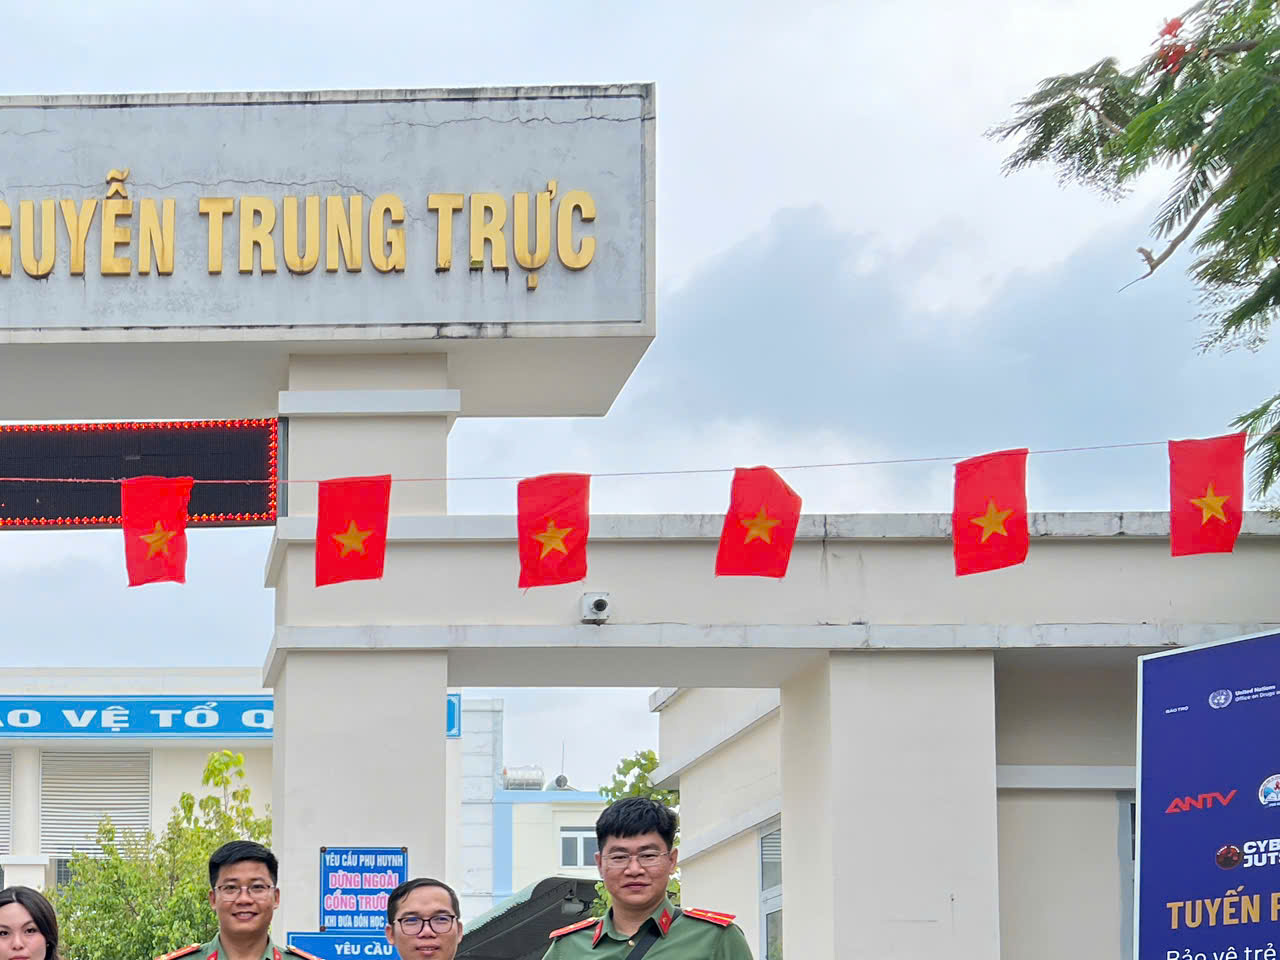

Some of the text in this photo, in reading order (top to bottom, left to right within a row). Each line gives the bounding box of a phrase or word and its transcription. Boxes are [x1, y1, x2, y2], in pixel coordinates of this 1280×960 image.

[198, 193, 406, 276] TRUNG
[427, 180, 597, 290] TRỰC
[61, 705, 131, 732] VỆ
[149, 701, 220, 729] TỔ
[1164, 789, 1238, 814] ANTV
[359, 854, 375, 869] PHỤ
[376, 854, 404, 867] HUYNH
[1243, 851, 1280, 868] JUT
[1166, 885, 1261, 930] TUYẾN
[334, 941, 393, 956] YÊU CẦU
